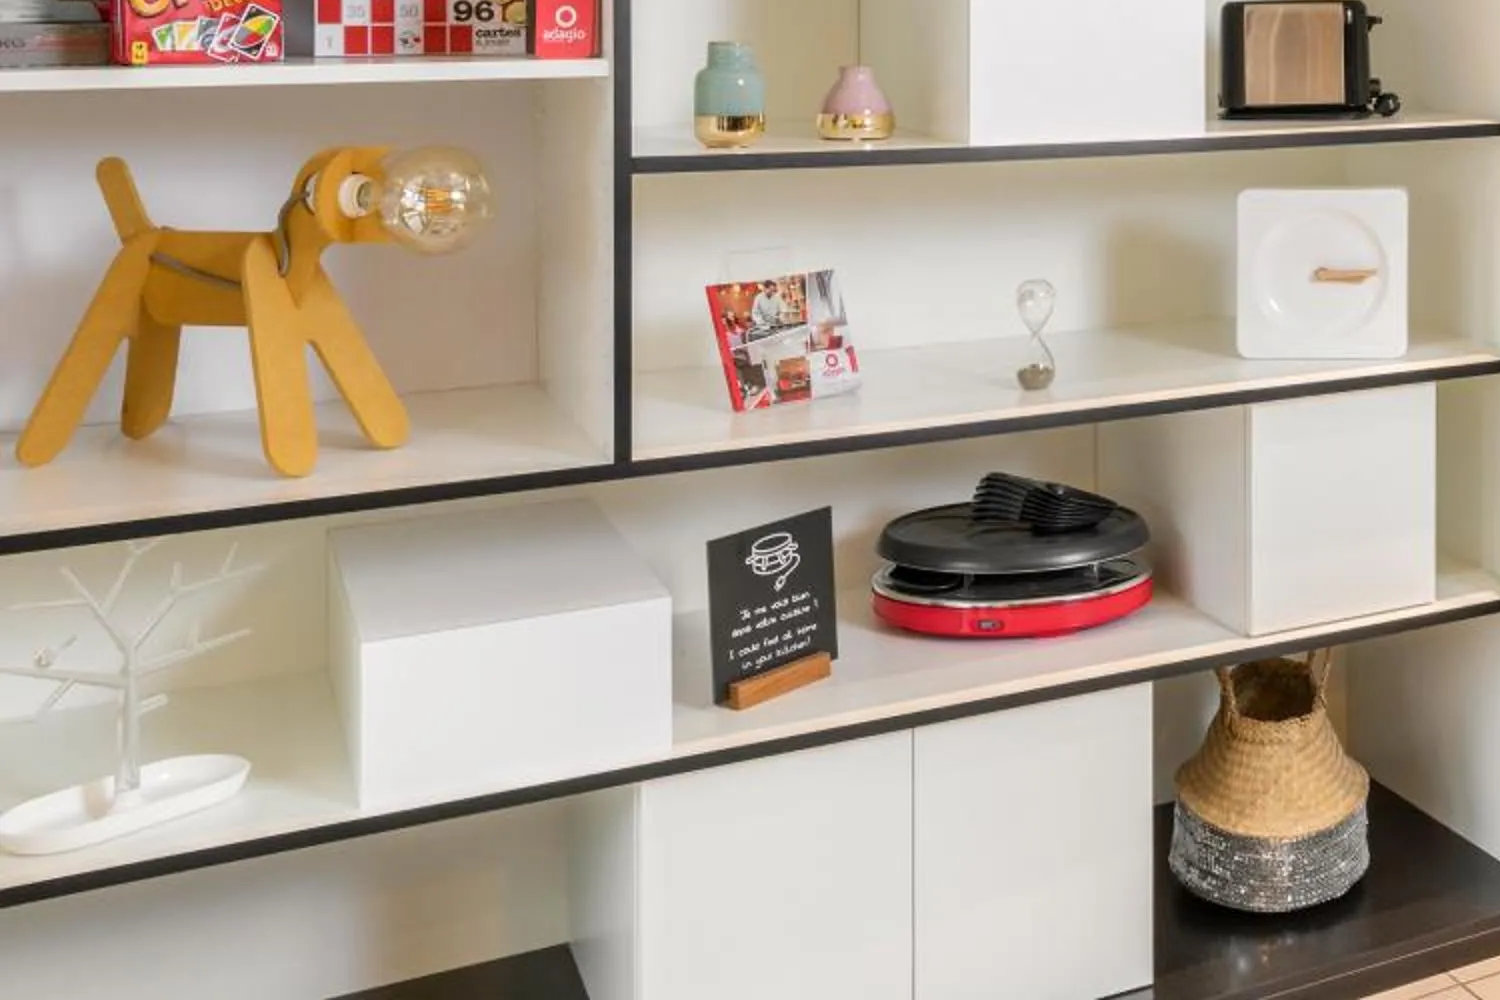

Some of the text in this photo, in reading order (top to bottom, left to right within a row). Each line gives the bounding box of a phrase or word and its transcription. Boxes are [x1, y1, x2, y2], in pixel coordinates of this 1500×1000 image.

[453, 0, 495, 22] 96
[475, 28, 521, 38] cartes
[543, 28, 586, 44] adagio
